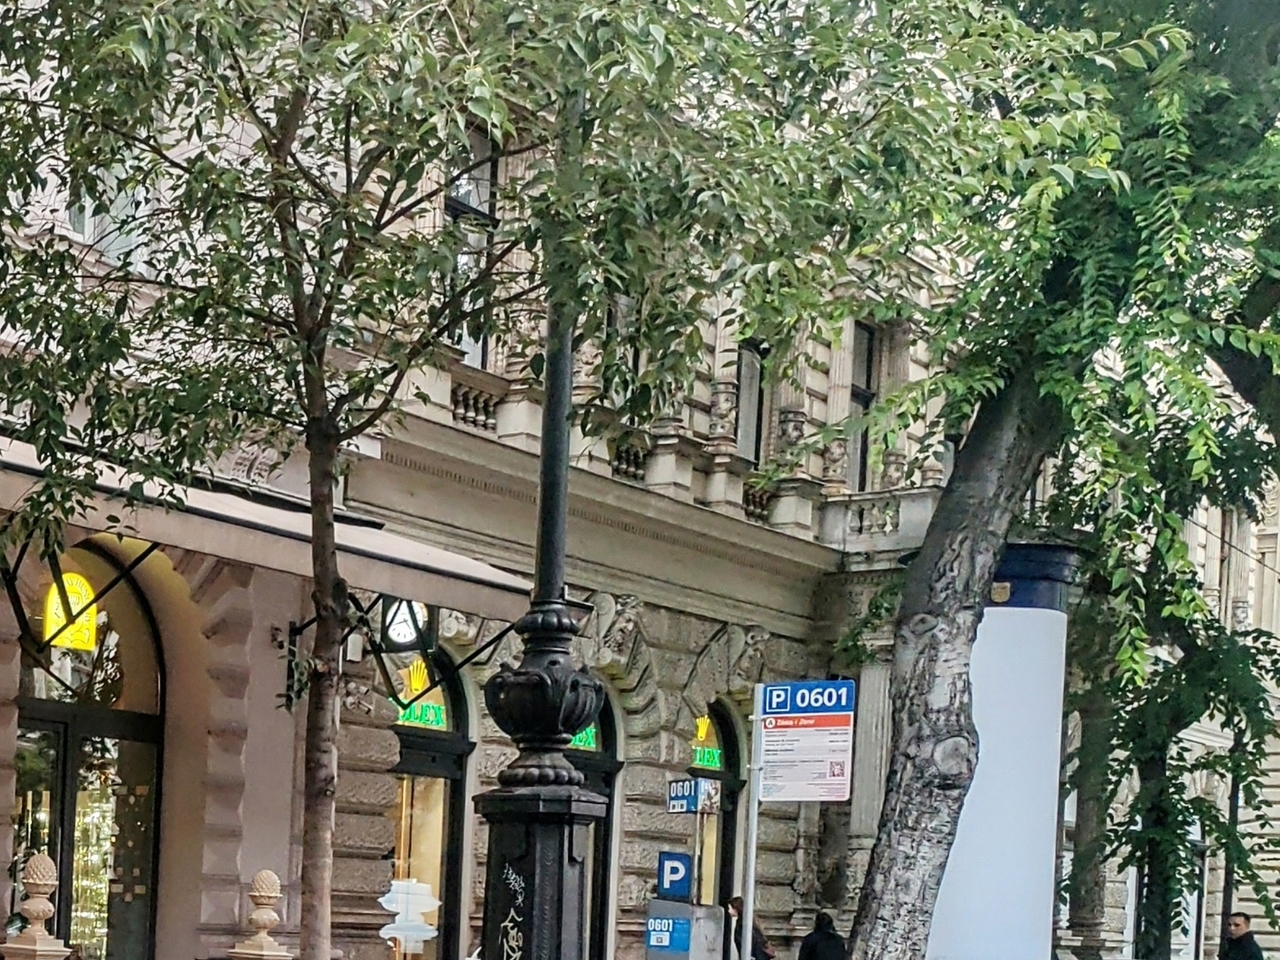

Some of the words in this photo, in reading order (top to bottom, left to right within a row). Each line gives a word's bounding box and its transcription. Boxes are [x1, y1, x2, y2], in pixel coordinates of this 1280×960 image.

[771, 690, 786, 709] P
[795, 687, 848, 708] 0601
[396, 698, 446, 727] LEX
[692, 746, 722, 767] LEX
[670, 781, 696, 798] 0601
[663, 860, 686, 889] P
[647, 918, 673, 932] 0601
